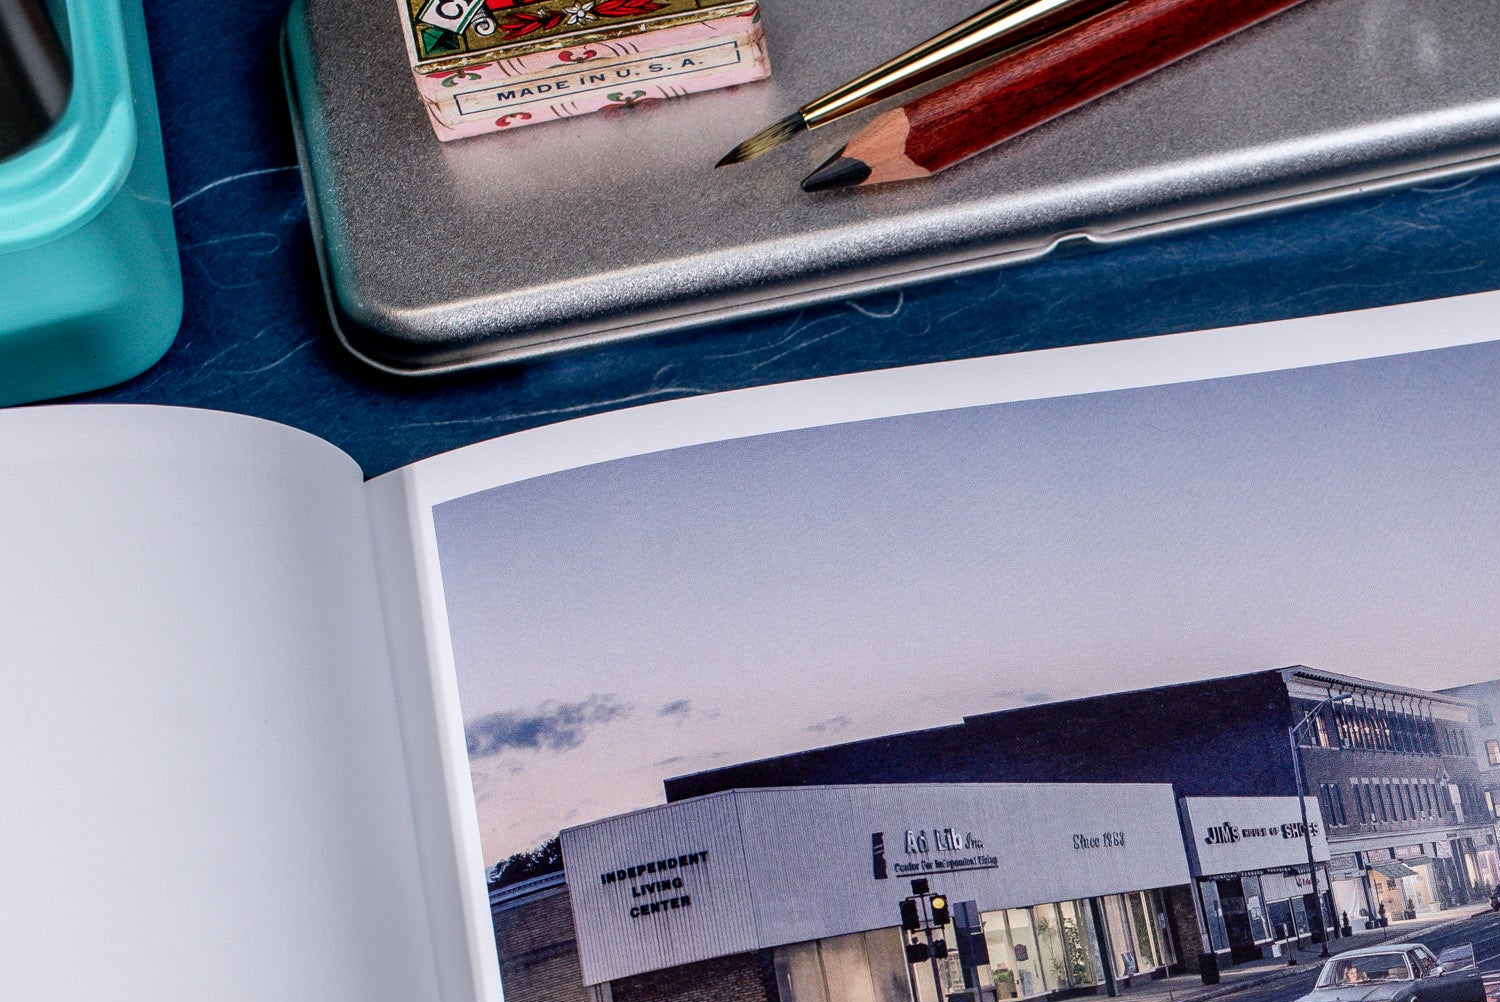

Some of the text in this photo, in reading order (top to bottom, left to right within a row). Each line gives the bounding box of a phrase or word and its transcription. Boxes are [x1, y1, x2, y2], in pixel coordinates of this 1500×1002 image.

[496, 80, 569, 101] MADE
[580, 73, 606, 86] IN
[935, 827, 962, 851] Lib
[1073, 833, 1100, 850] Since
[601, 850, 708, 885] INDEPENDENT
[632, 877, 682, 898] LIVING
[630, 895, 691, 918] CENTER
